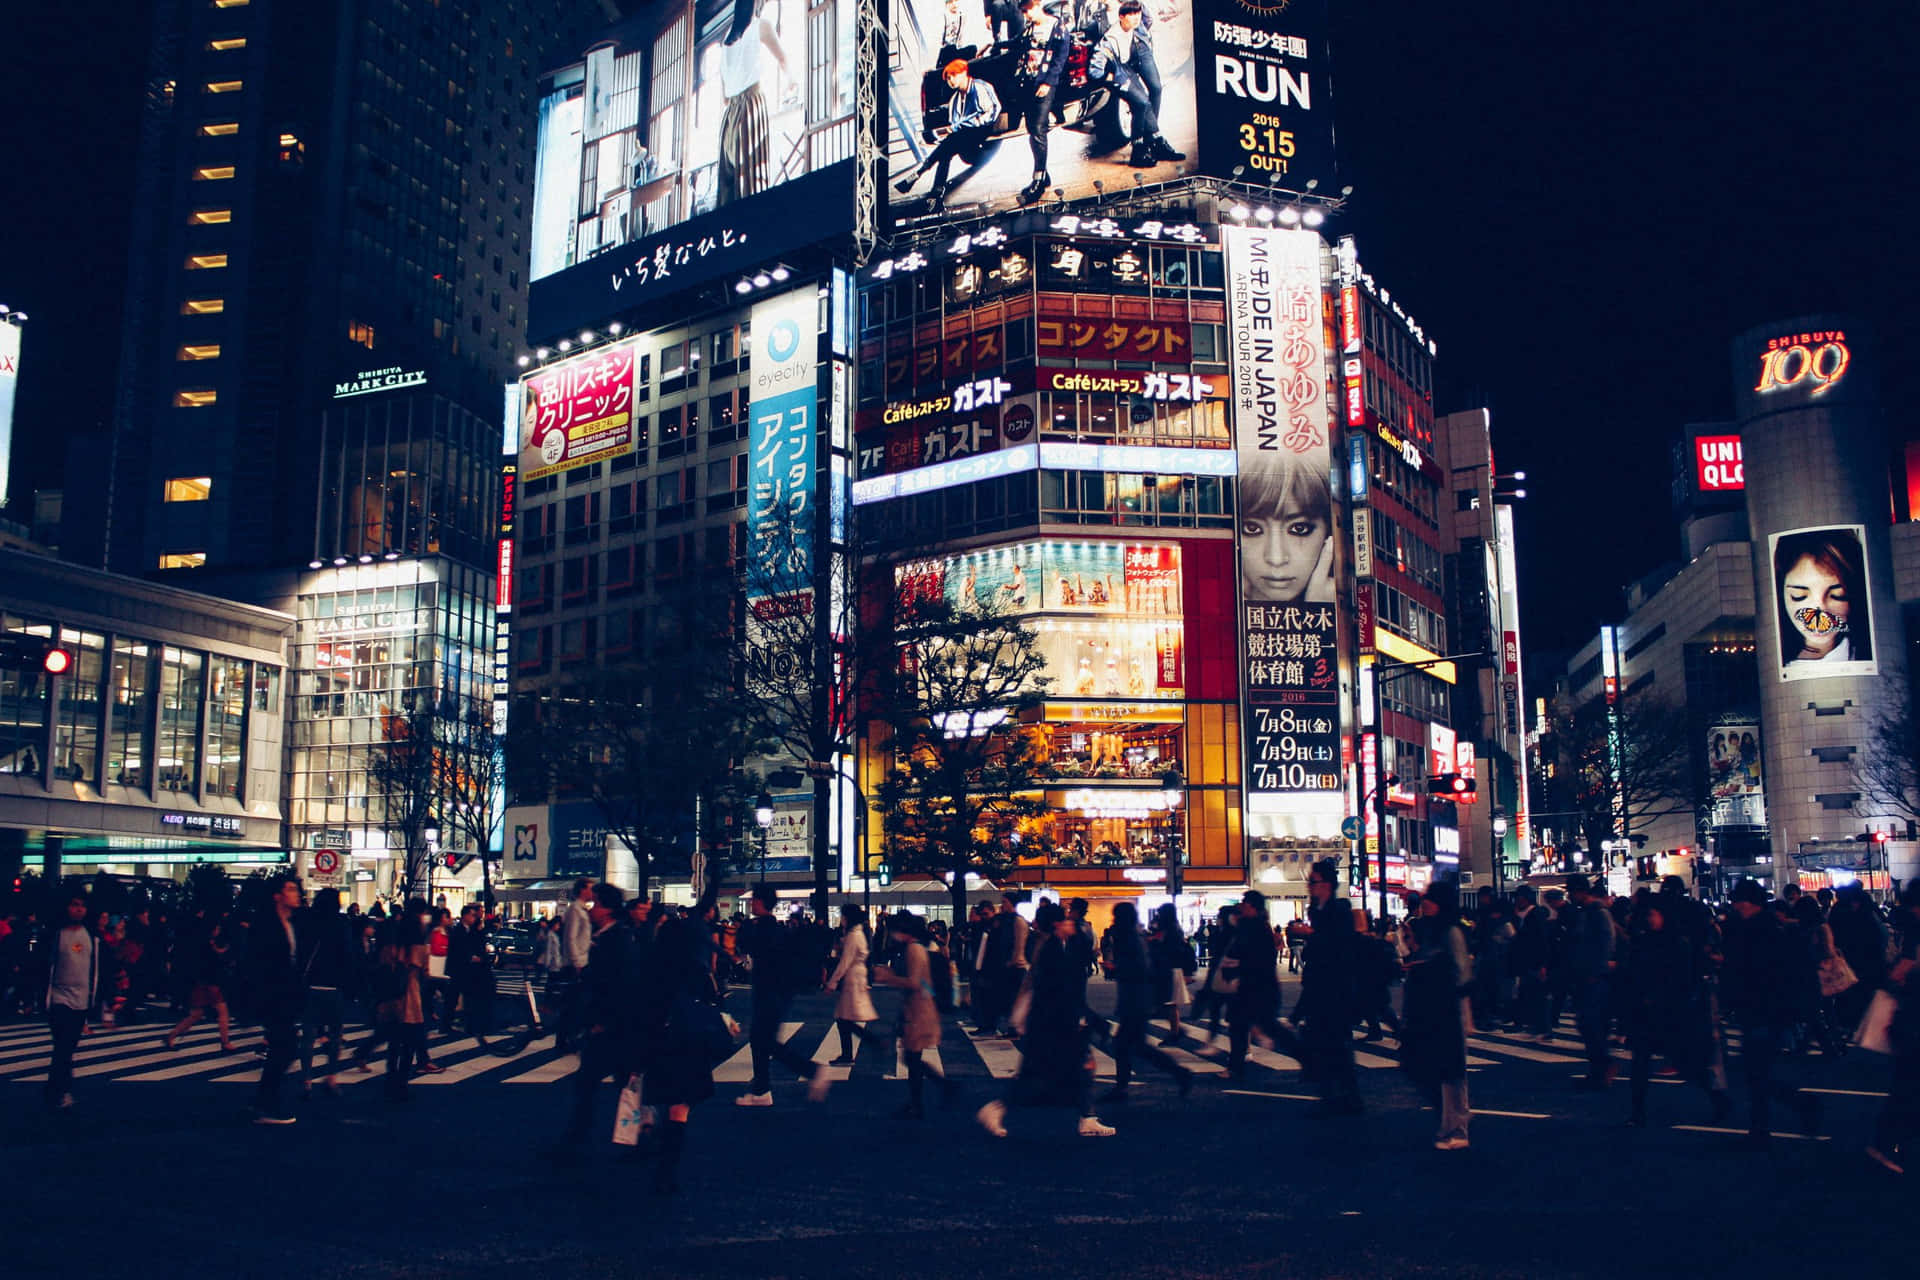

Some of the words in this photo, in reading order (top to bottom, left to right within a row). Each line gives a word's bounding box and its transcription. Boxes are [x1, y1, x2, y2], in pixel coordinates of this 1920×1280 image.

[1216, 55, 1311, 110] RUN
[1253, 113, 1280, 127] 2016
[1240, 123, 1296, 157] 3.15
[1250, 154, 1288, 174] OUT!
[611, 228, 748, 291] いち髪なひと。
[1236, 273, 1248, 320] ARENA
[1039, 322, 1184, 353] コンタクト
[1238, 324, 1250, 361] TOUR
[1768, 330, 1845, 349] SHIBUYA
[1253, 339, 1274, 363] IN
[1276, 265, 1323, 454] 崎あゆみ
[358, 366, 402, 379] SHIBUYA
[758, 361, 809, 389] eyecity
[1754, 341, 1851, 394] 109
[335, 378, 382, 394] MARK
[385, 370, 424, 385] CITY
[539, 355, 632, 408] 品川スキン
[1052, 373, 1140, 393] Caféレストラン
[1143, 371, 1214, 401] ガスト
[1240, 366, 1252, 396] 2016
[540, 383, 631, 434] クリニック
[883, 397, 951, 424] Caféレストラン
[954, 376, 1012, 413] ガスト
[1255, 368, 1278, 451] JAPAN
[1007, 419, 1031, 432] ガスト
[924, 420, 993, 464] ガスト
[1702, 443, 1742, 462] UNI
[547, 450, 559, 462] 4F
[860, 446, 885, 470] 7F
[756, 412, 784, 576] アイシティ
[787, 405, 807, 573] コンタクトの
[1247, 606, 1333, 631] 国立代々木
[1248, 634, 1336, 658] 競技場第一
[1250, 660, 1304, 685] 体育館
[1314, 658, 1328, 677] 3
[1281, 692, 1306, 702] 2016
[1255, 708, 1332, 733] 7月8日(金)
[1256, 736, 1333, 761] 7月9日(土)
[1253, 763, 1338, 789] 7月10日(日)
[213, 817, 241, 830] 渋谷駅
